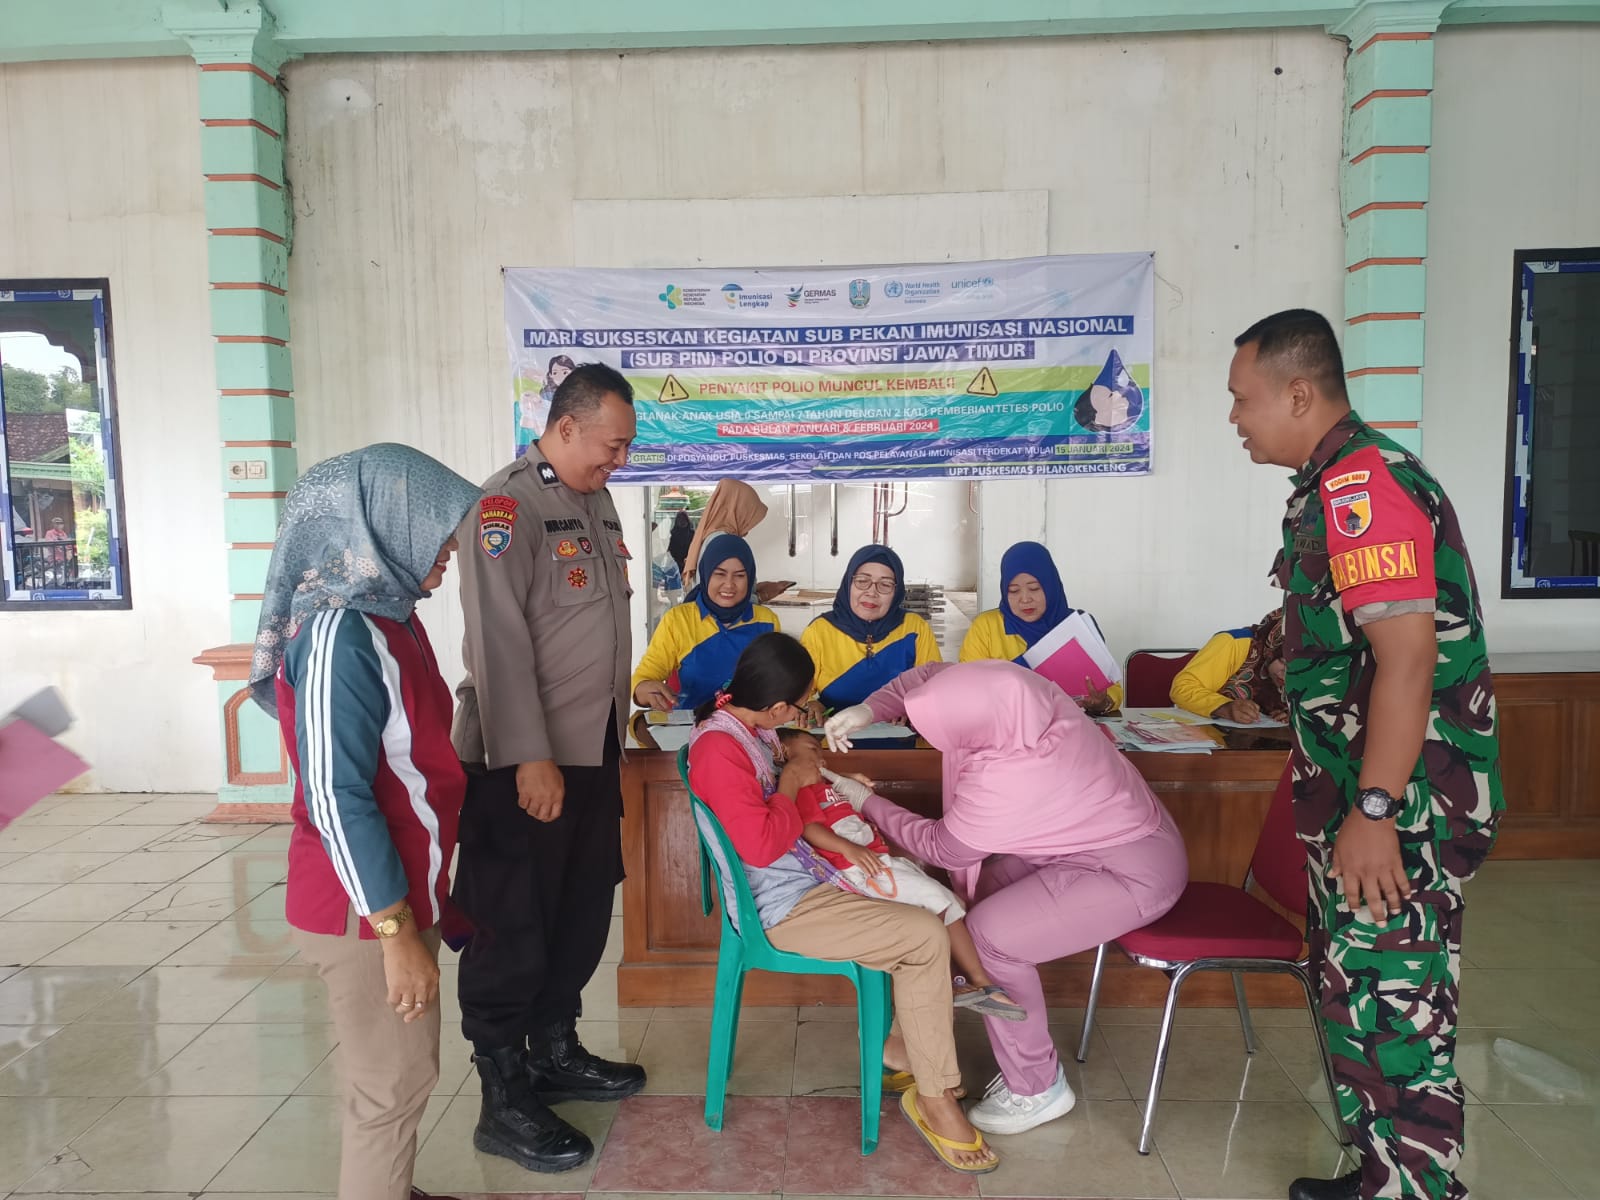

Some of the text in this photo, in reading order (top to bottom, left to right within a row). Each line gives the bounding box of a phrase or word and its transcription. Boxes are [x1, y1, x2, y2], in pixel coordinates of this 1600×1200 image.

[951, 278, 982, 289] unicef
[739, 292, 773, 300] Imunisasi
[803, 289, 837, 297] GERMAS
[904, 288, 940, 296] Organization
[739, 300, 769, 308] Lengkap
[529, 318, 1127, 346] MARI SUKSESKAN KEGIATAN SUB PEKAN IMUNISASI NASIONAL
[629, 343, 1026, 367] (SUB PIN) POLIO DI PROVINSI JAWA TIMUR
[699, 381, 768, 395] PENYAKIT
[772, 380, 815, 393] POLIO
[818, 378, 882, 393] MUNCUL
[649, 411, 712, 421] ANAK-ANAK
[716, 411, 741, 421] USIA
[754, 410, 795, 421] SAMPAI
[805, 407, 842, 419] TAHUN
[844, 407, 892, 419] DENGAN
[894, 408, 900, 418] 2
[902, 407, 928, 418] KALI
[930, 404, 994, 416] PEMBERIAN
[996, 403, 1029, 414] TETES
[1031, 402, 1065, 413] POLIO
[722, 420, 934, 435] PADA BULAN JANUARI & FEBRUARI 2024
[633, 453, 665, 463] GRATIS
[667, 453, 677, 462] DI
[789, 451, 830, 460] SEKOLAH
[833, 451, 851, 460] DAN
[853, 451, 872, 460] POS
[874, 450, 926, 460] PELAYANAN
[928, 448, 975, 458] IMUNISASI
[977, 446, 1022, 457] TERDEKAT
[1024, 446, 1055, 455] MULAI
[1055, 446, 1066, 454] 15
[1067, 445, 1107, 453] JANUARI
[1109, 444, 1130, 453] 2024
[949, 463, 1128, 476] UPT PUSKESMAS PILANGKENCENG
